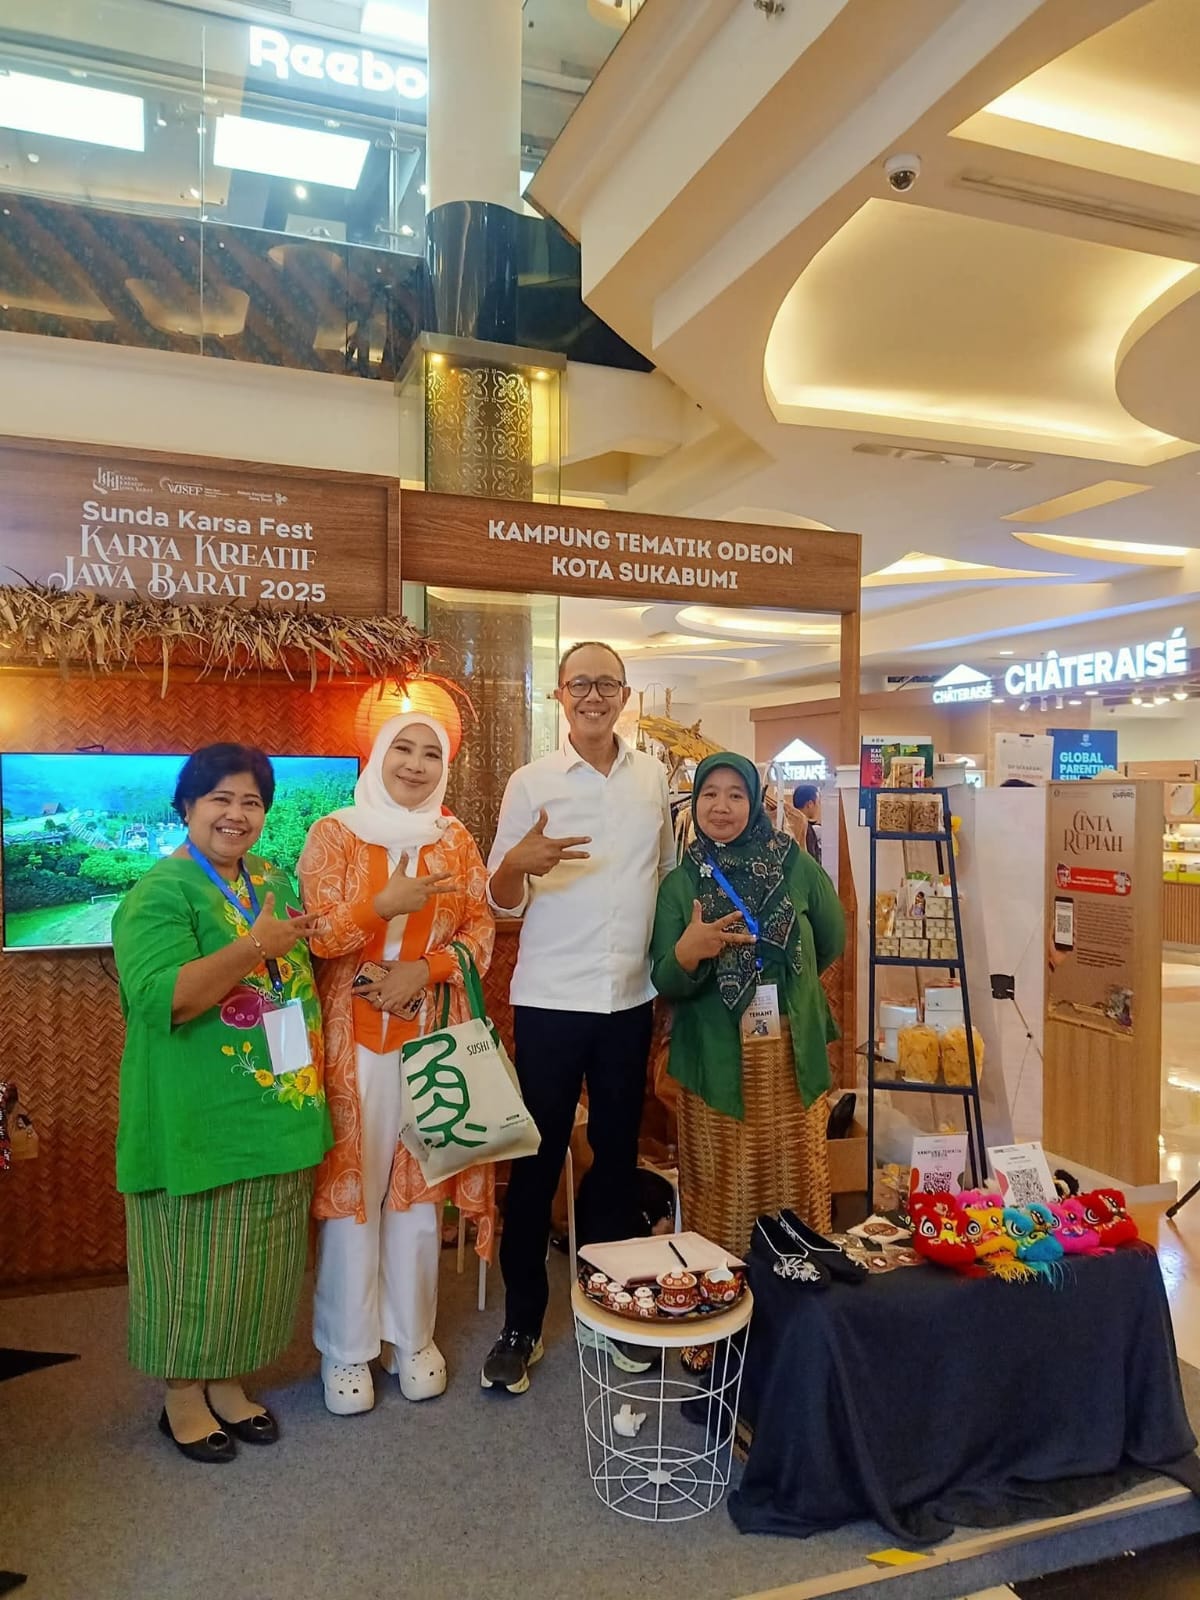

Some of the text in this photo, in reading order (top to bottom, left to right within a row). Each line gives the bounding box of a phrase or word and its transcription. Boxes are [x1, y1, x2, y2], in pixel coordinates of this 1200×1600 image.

[82, 501, 314, 540] Sunda Karsa Fest
[80, 524, 318, 573] KARYA KREATIF
[488, 519, 793, 565] KAMPUNG TEMATIK ODEON
[47, 555, 326, 603] JAWA BARAT 2025
[552, 556, 738, 590] KOTA SUKABUMI
[1004, 626, 1188, 696] CHÂTERAISÉ
[1060, 752, 1103, 763] GLOBAL
[1073, 809, 1112, 835] CINTA
[1064, 829, 1123, 855] RUPIAH
[466, 1040, 490, 1055] SUSHI
